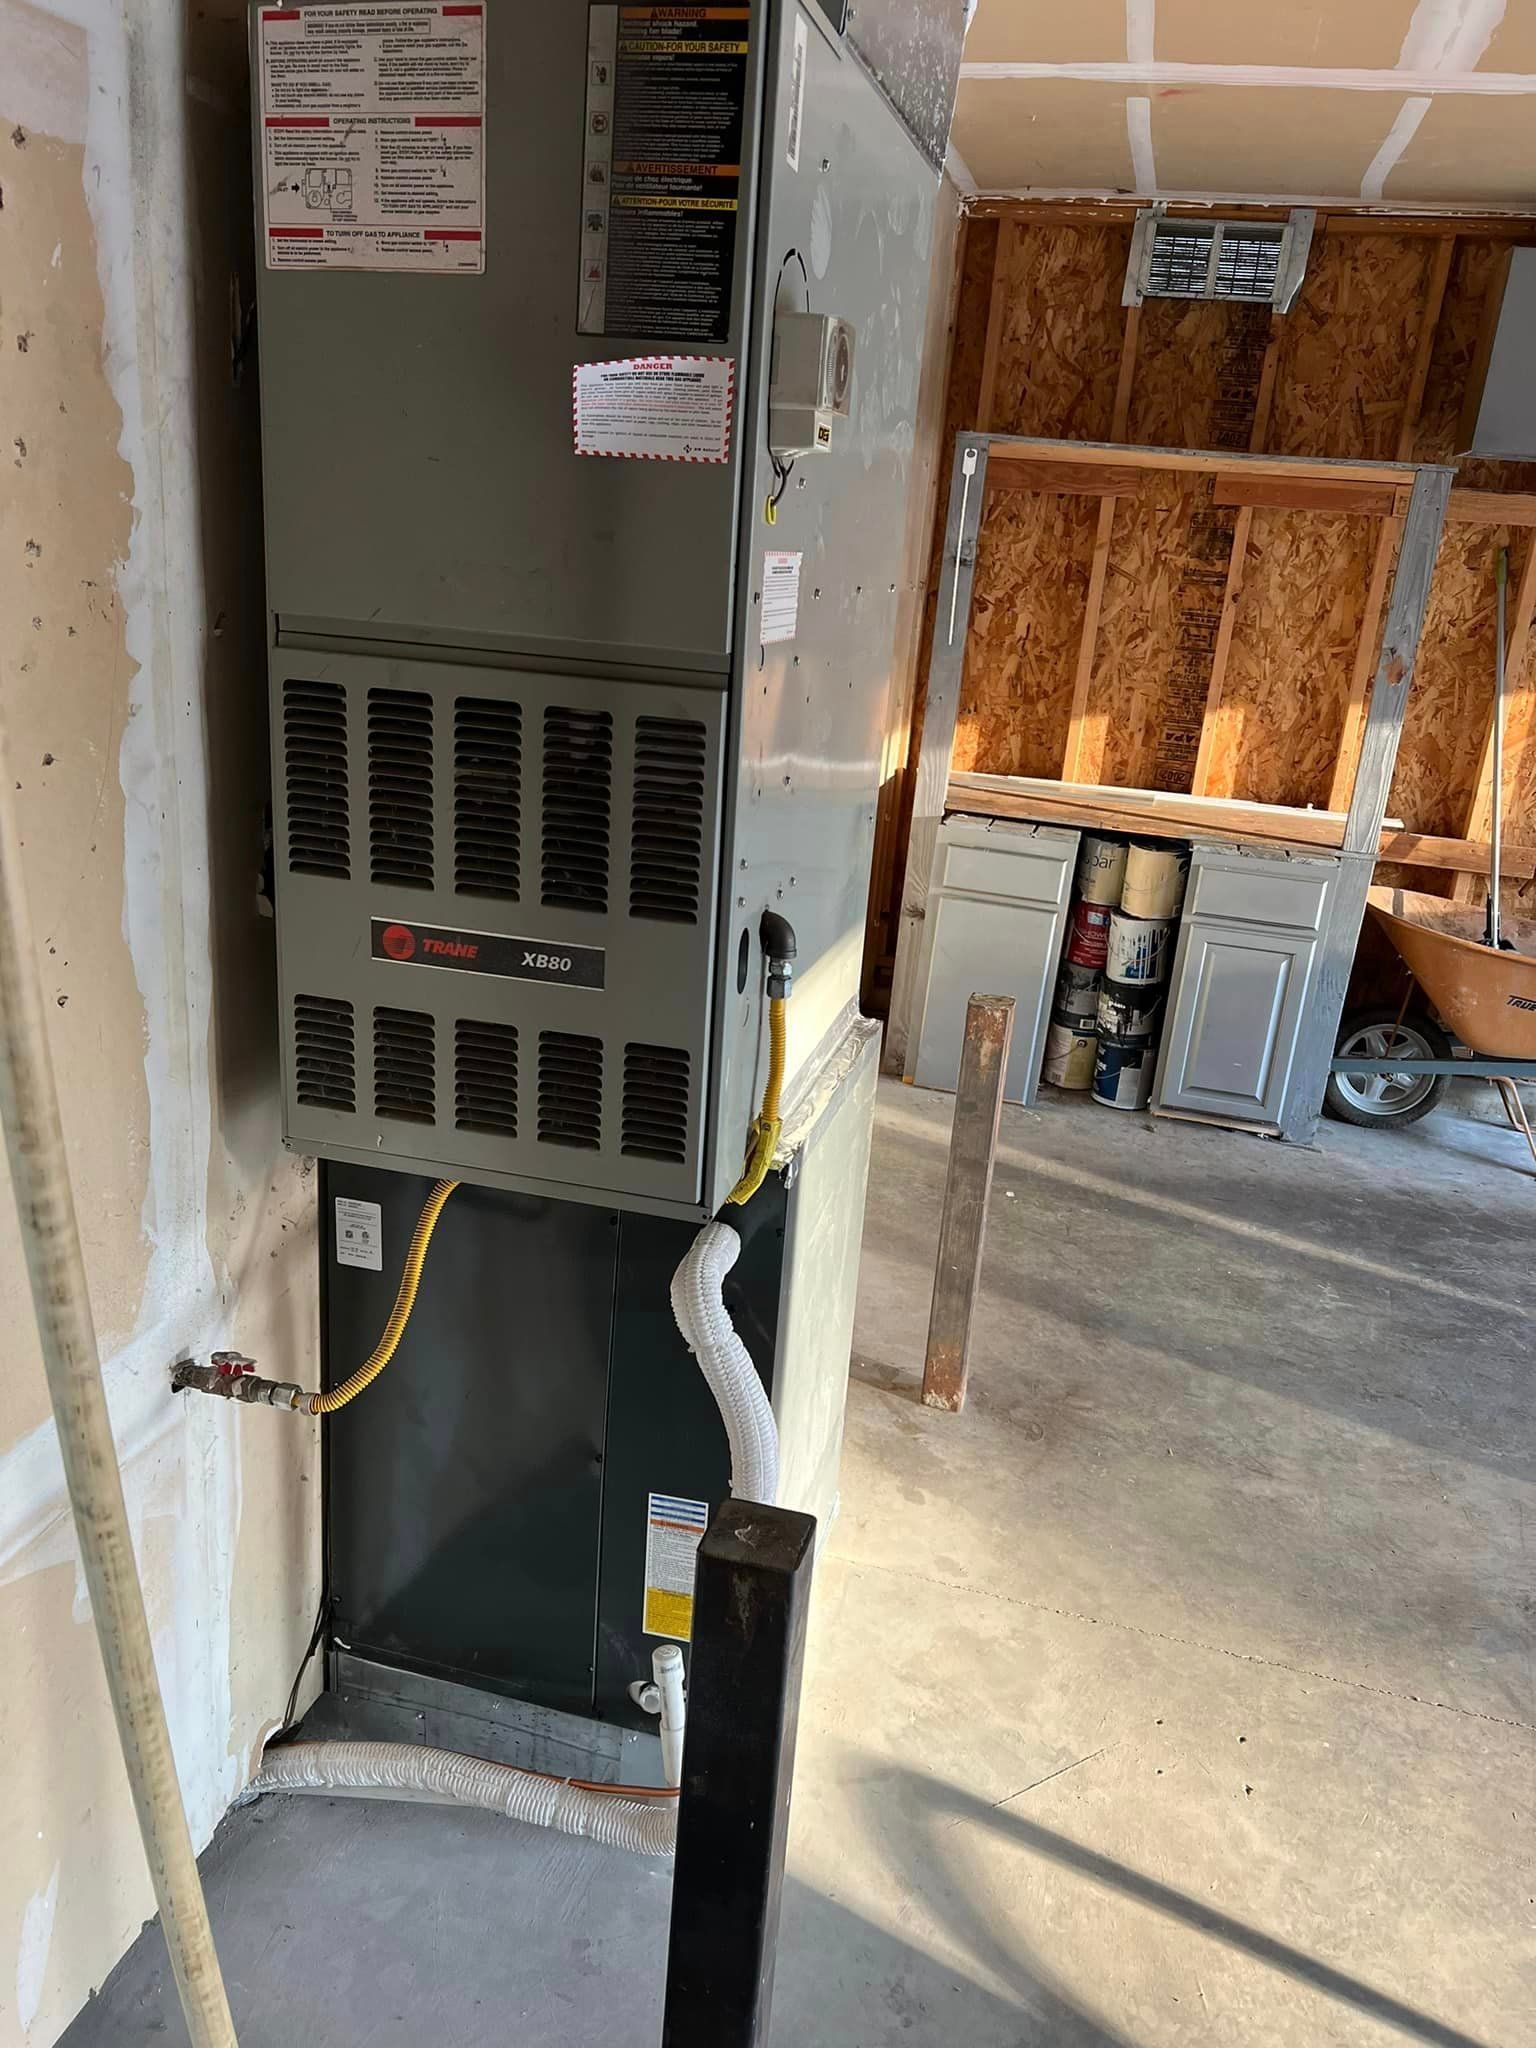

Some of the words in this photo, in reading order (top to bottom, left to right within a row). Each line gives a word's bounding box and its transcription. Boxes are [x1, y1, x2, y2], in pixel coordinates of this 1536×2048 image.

[335, 9, 358, 17] SAFETY
[359, 8, 375, 16] READ
[376, 8, 401, 16] BEFORE
[402, 7, 438, 15] OPERATING
[656, 8, 707, 18] WARNING
[685, 43, 706, 53] YOUR
[708, 43, 739, 53] SAFETY
[333, 117, 366, 125] OPERATING
[634, 162, 719, 175] AVERTISSEMENT
[678, 199, 699, 208] VOTRE
[387, 231, 420, 239] APPLIANCE
[1166, 732, 1196, 743] APA
[422, 938, 479, 959] TRANE
[521, 951, 572, 972] XB80
